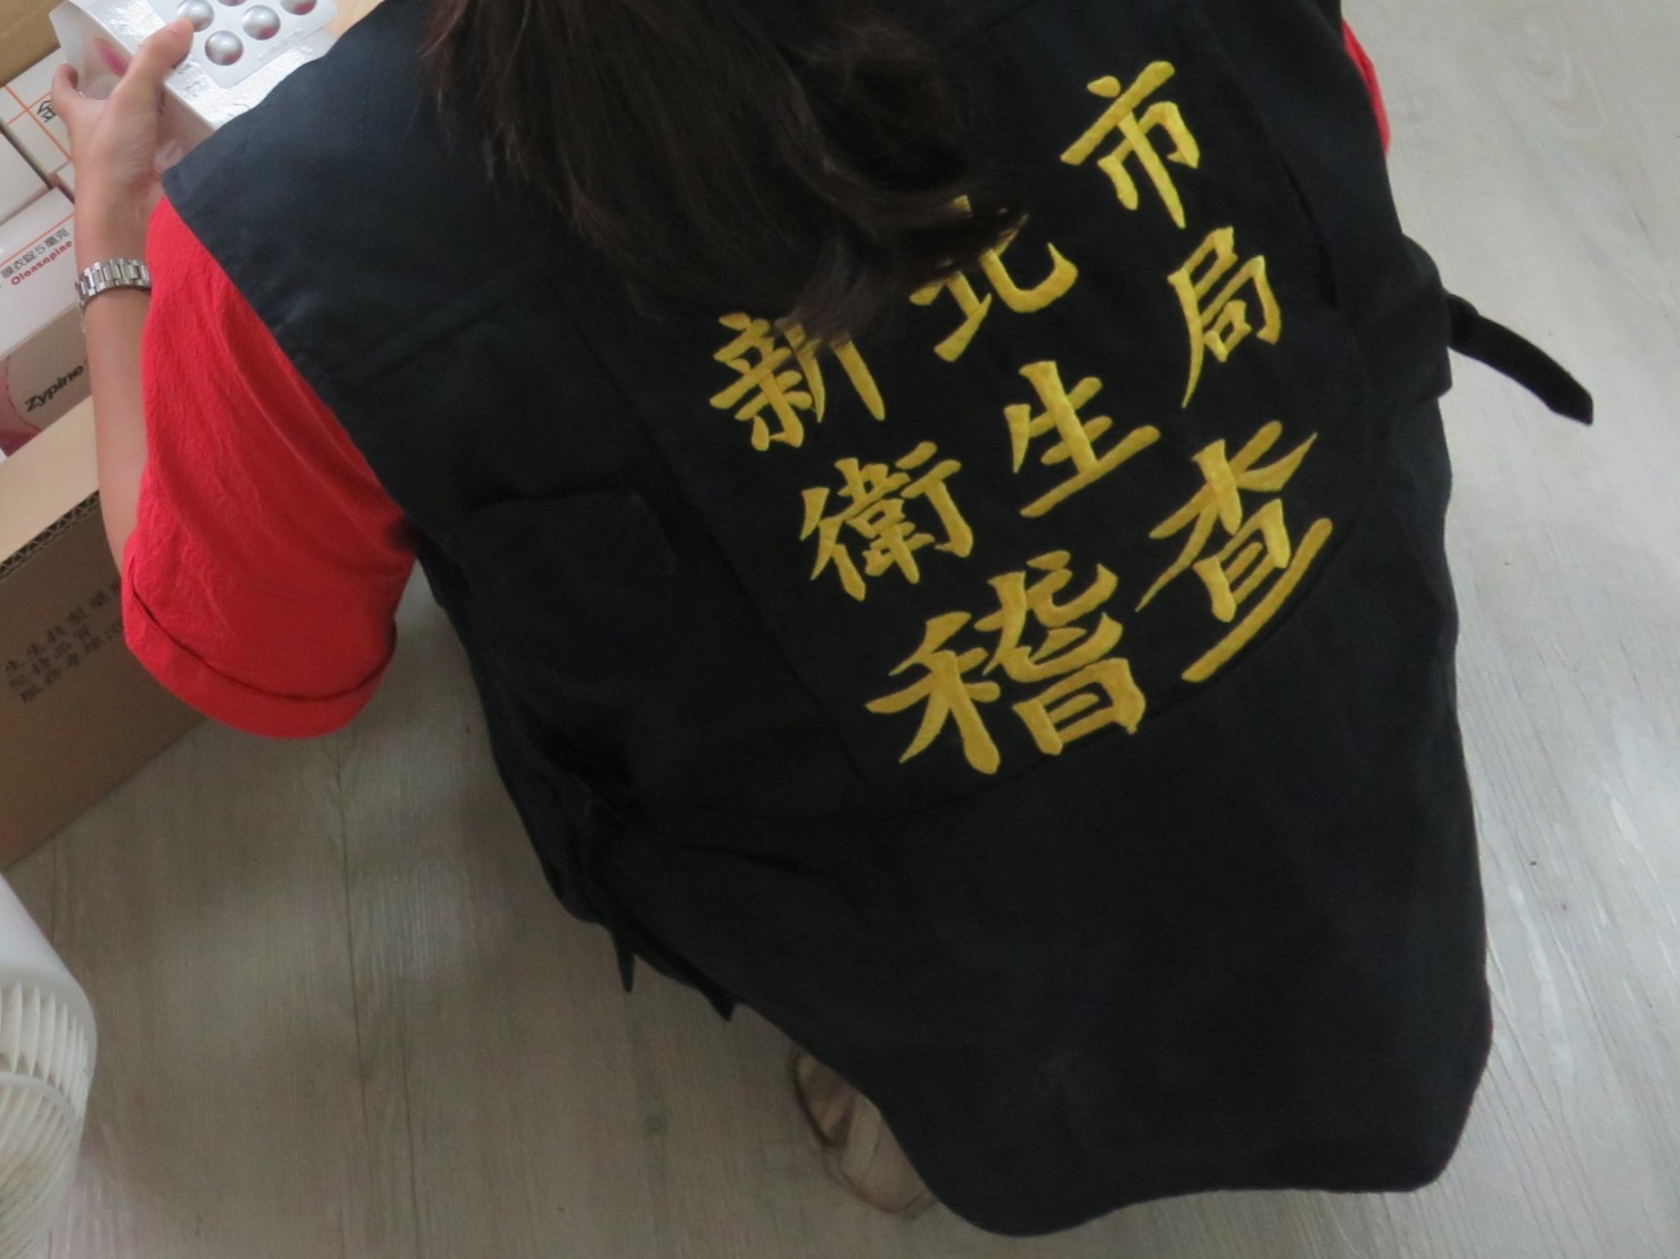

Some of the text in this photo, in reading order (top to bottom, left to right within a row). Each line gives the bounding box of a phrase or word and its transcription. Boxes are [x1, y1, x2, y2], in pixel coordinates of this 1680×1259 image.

[11, 240, 72, 285] Olanzapine
[25, 365, 84, 412] Zypine
[709, 60, 1200, 452] 新北市
[800, 226, 1281, 601] 衛生局
[865, 420, 1333, 774] 稽查
